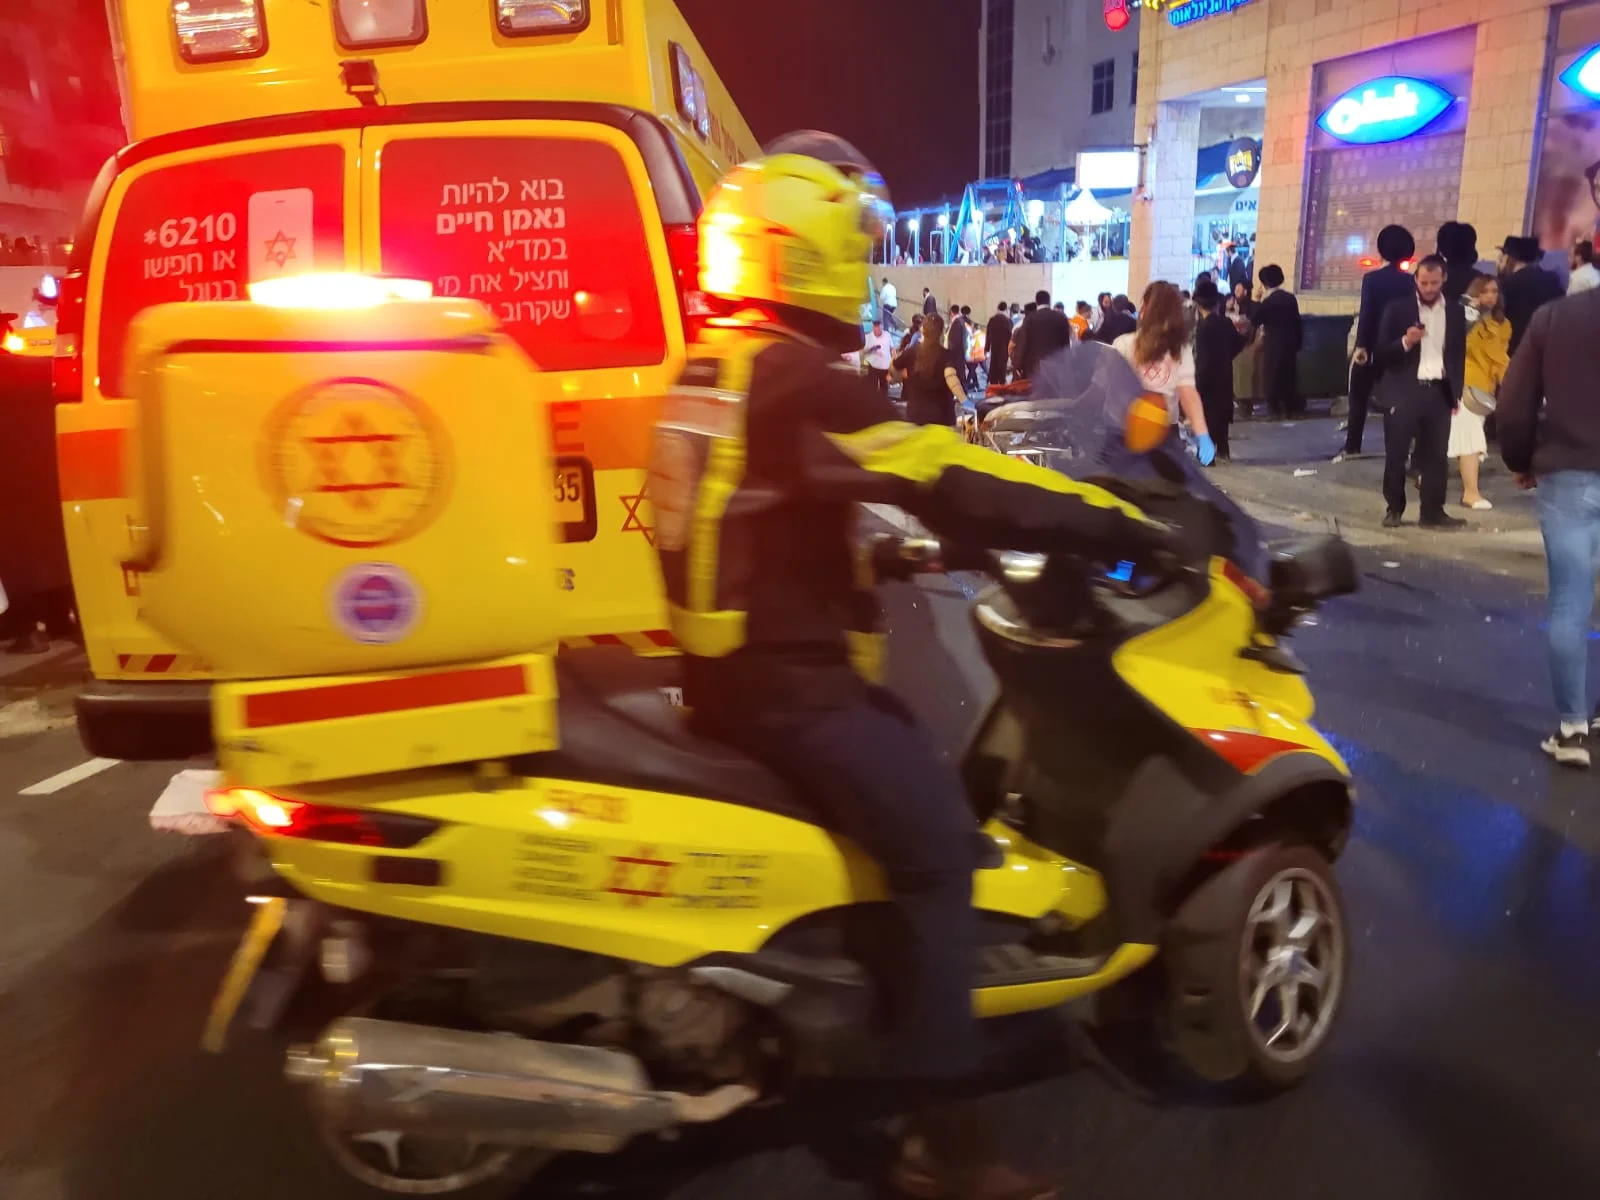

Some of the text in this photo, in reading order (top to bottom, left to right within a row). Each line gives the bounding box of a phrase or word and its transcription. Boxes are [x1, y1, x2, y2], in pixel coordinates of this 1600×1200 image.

[440, 176, 565, 206] בוא להיות
[436, 207, 566, 236] נאמן חיים
[143, 249, 236, 279] או חפשו
[469, 273, 502, 294] את
[509, 267, 569, 291] ותציל
[501, 299, 571, 326] שקרוב
